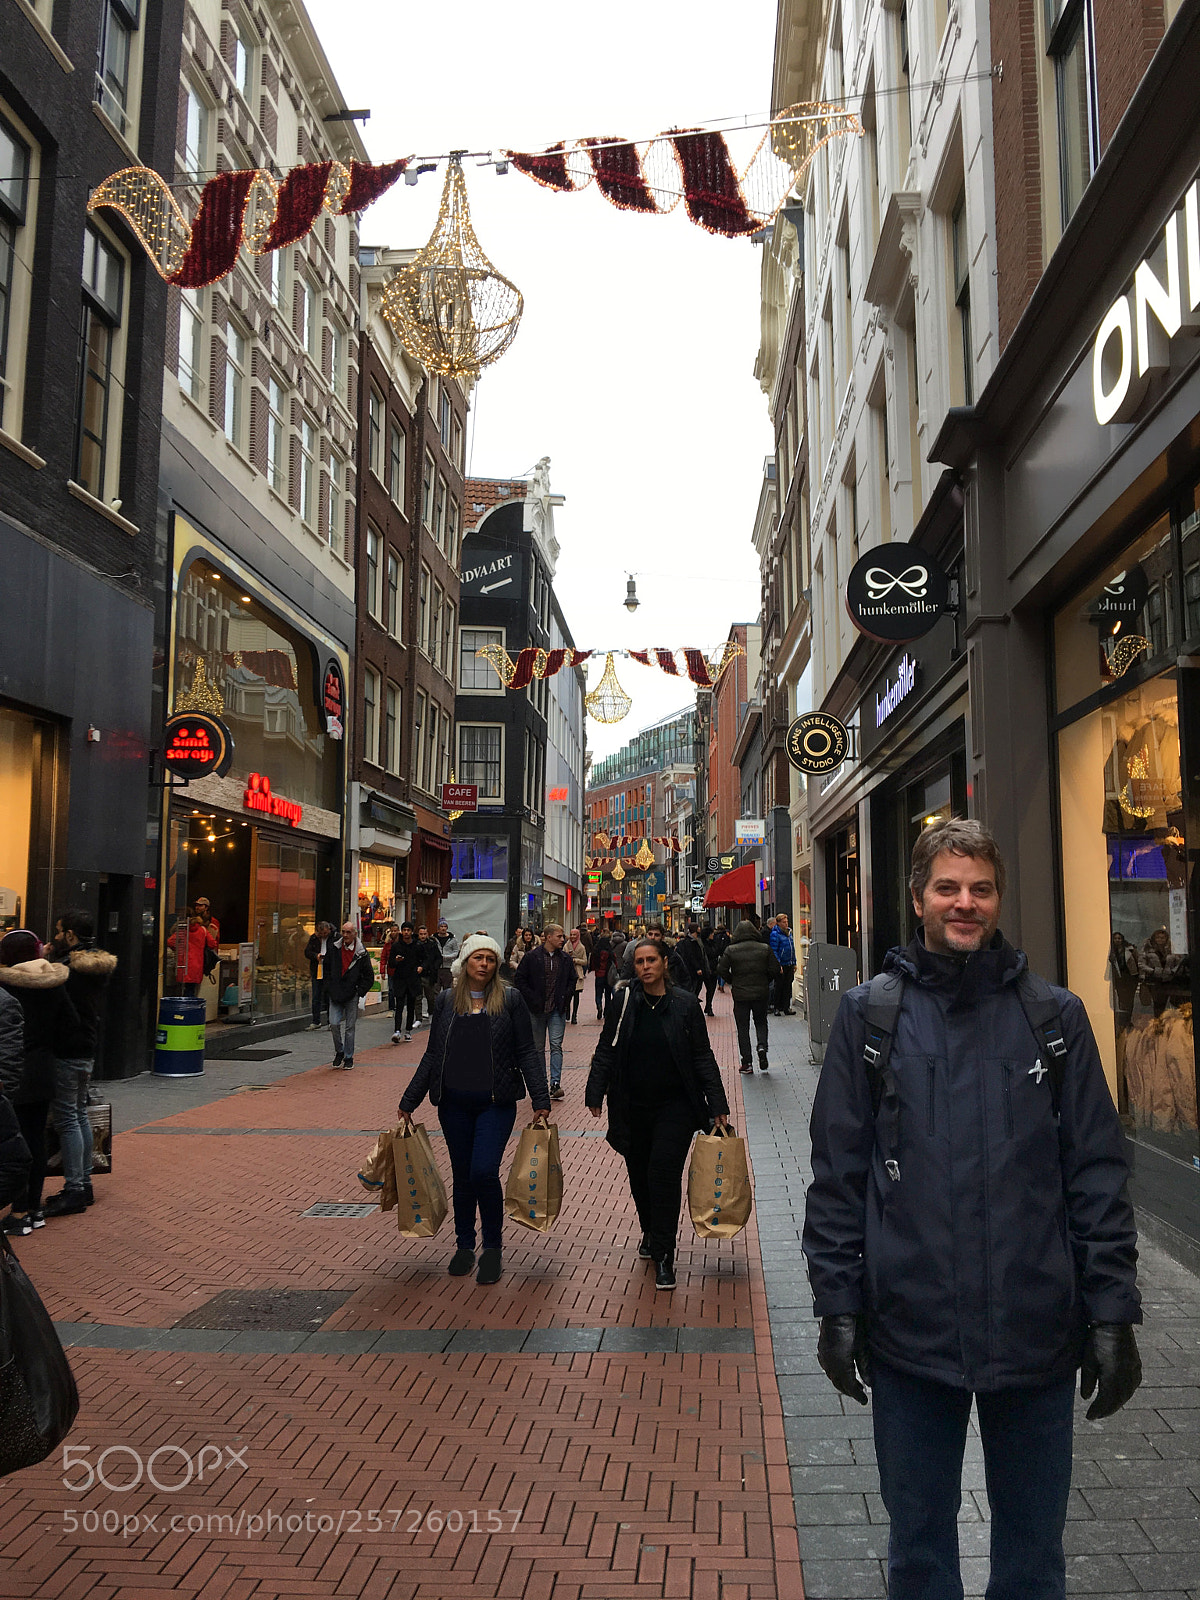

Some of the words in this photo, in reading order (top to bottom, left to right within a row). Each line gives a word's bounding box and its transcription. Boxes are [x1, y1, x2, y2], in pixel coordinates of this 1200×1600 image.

[859, 600, 939, 616] hunkemöller
[791, 727, 802, 756] JEANS
[801, 717, 844, 756] INTELLIGENCE
[801, 757, 834, 769] STUDIO
[448, 787, 472, 797] CAFE
[742, 837, 759, 845] ATM
